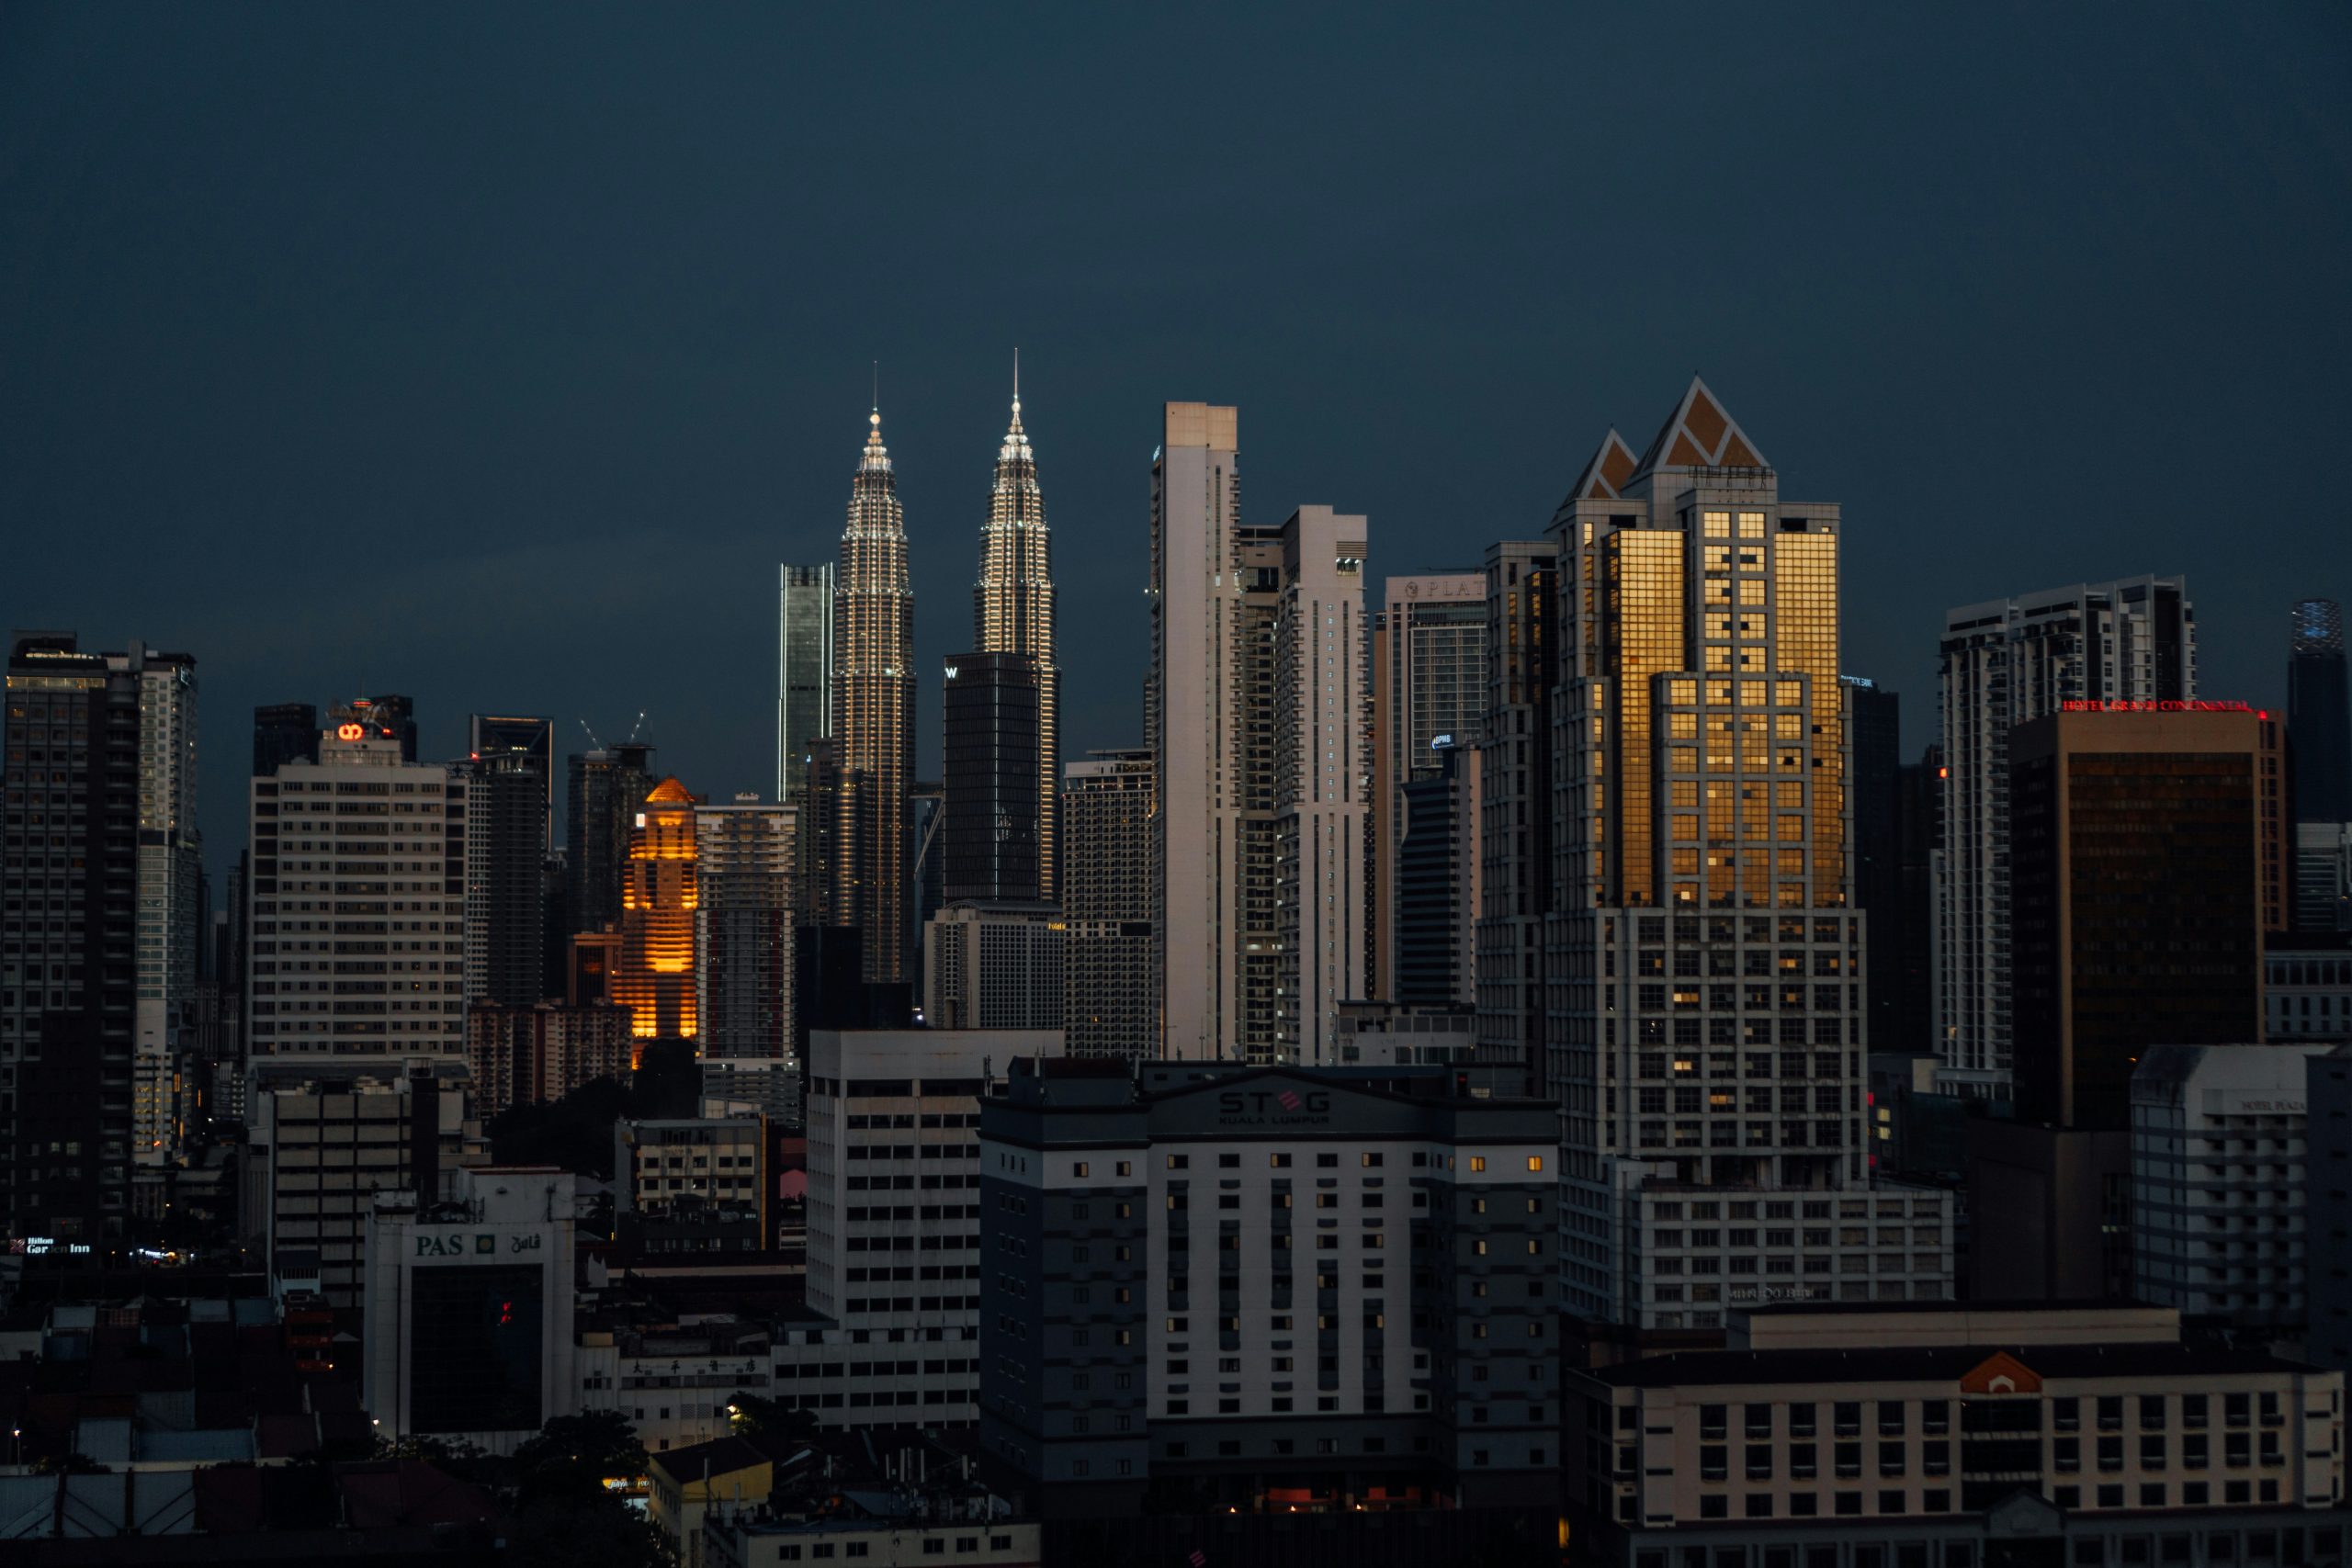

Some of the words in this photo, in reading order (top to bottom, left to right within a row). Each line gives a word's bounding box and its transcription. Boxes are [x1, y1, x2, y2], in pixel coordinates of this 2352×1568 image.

[945, 667, 958, 679] W
[2063, 700, 2105, 712] HOTEL
[2109, 700, 2157, 712] GRAND
[1219, 1116, 1265, 1125] KUALA
[1272, 1116, 1330, 1125] LUMPUR
[70, 1243, 91, 1253] Inn
[415, 1234, 464, 1257] PAS
